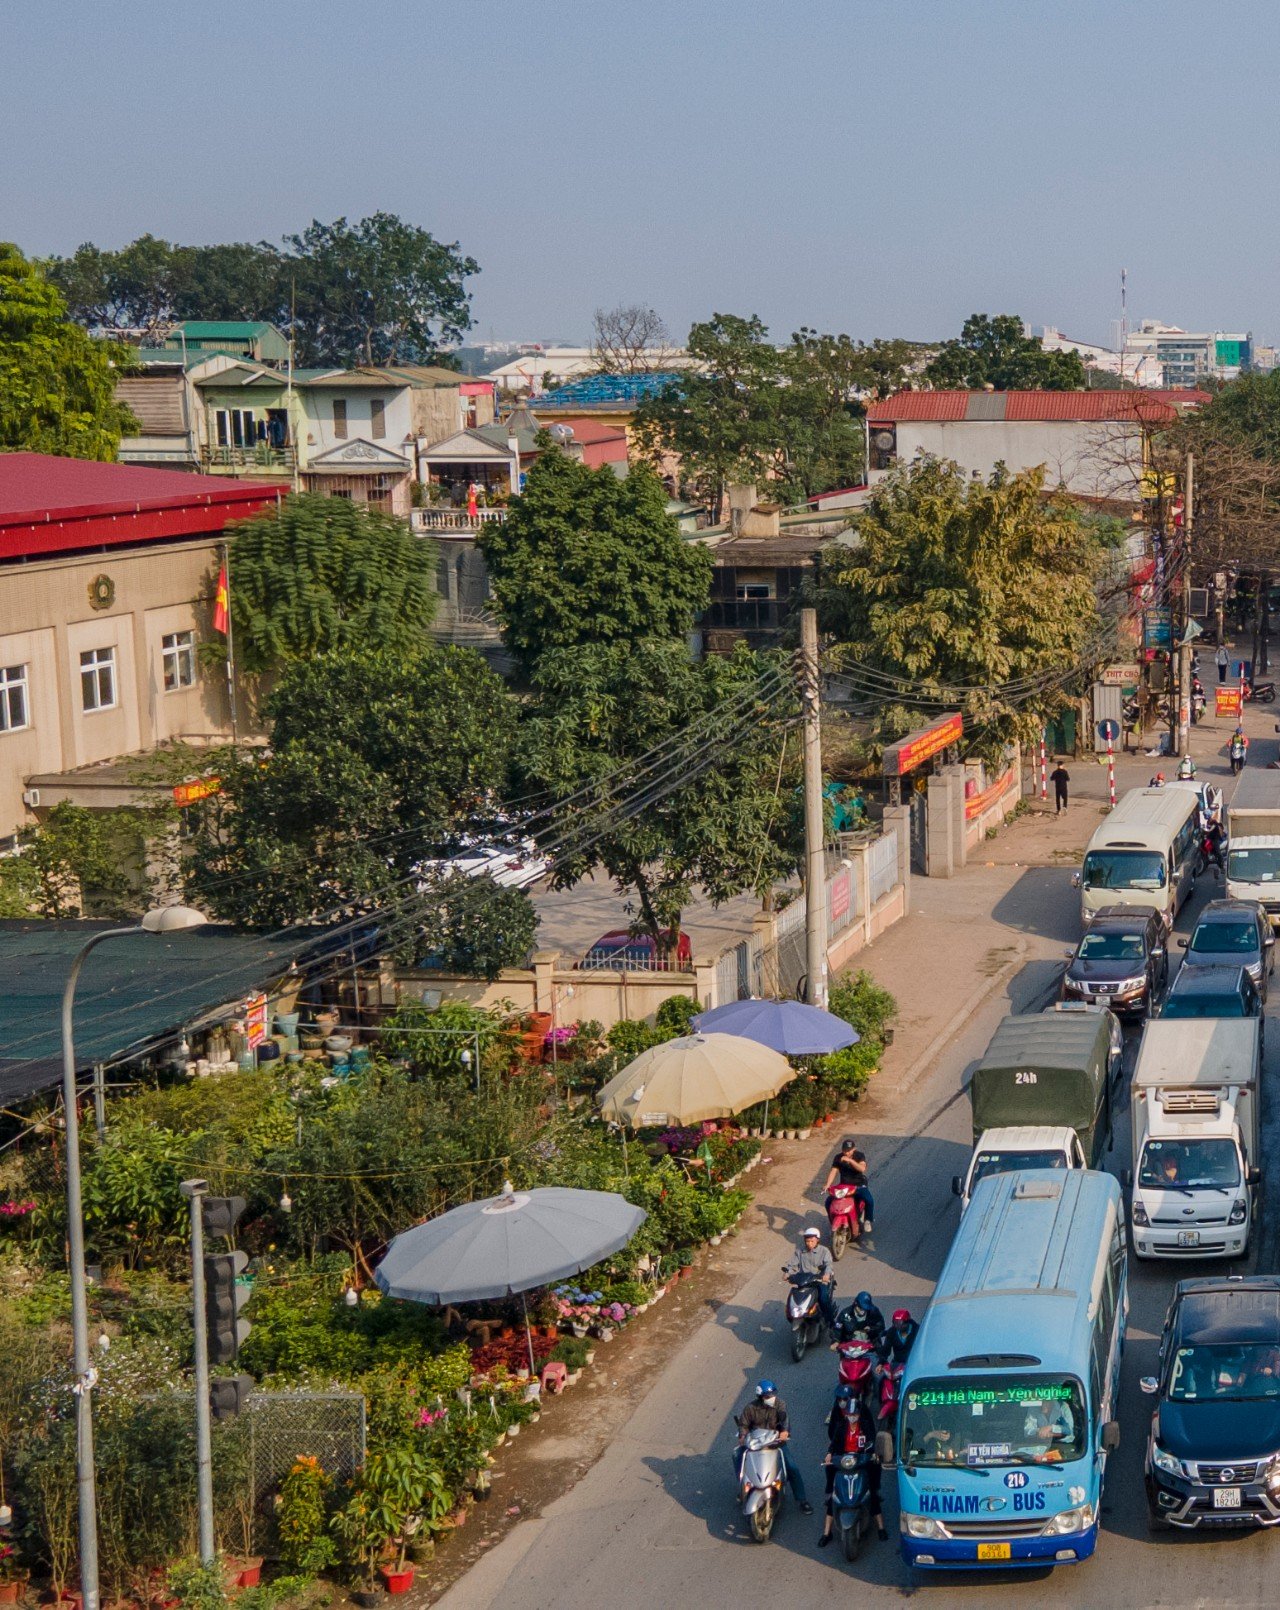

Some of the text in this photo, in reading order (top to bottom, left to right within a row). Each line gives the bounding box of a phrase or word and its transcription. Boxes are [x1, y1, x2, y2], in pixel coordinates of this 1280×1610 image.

[1015, 1072, 1037, 1084] 24h
[922, 1391, 944, 1403] 214
[948, 1389, 965, 1401] Hà
[968, 1389, 995, 1401] Nam
[1007, 1387, 1031, 1400] Yên
[1008, 1473, 1025, 1488] 214
[942, 1494, 979, 1513] NAM
[1013, 1491, 1045, 1511] BUS
